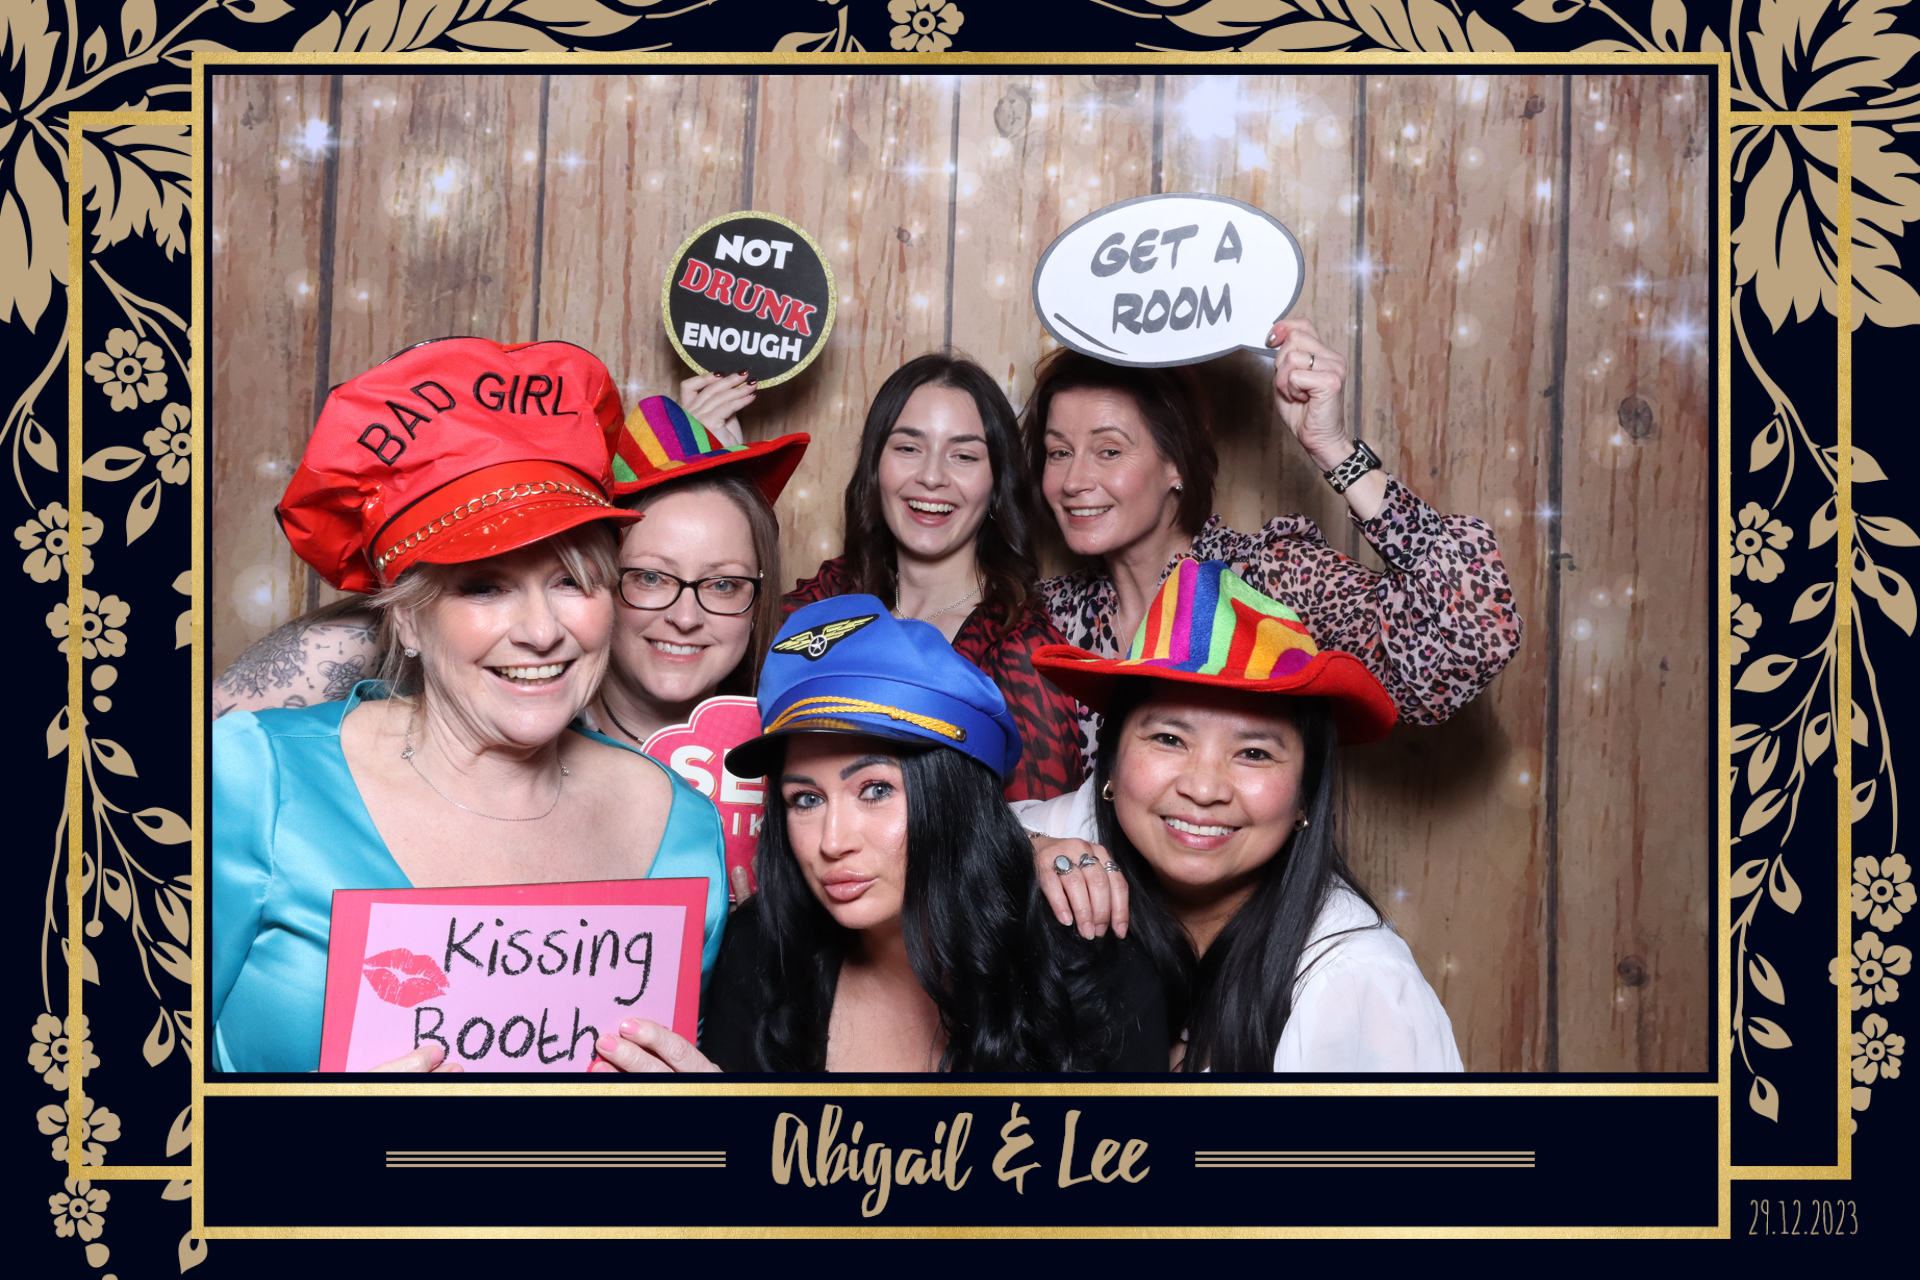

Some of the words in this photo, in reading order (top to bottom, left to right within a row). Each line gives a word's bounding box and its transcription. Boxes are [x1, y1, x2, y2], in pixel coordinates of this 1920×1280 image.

[714, 233, 794, 270] NOT
[1090, 224, 1200, 278] GET
[1213, 220, 1243, 264] A
[678, 257, 818, 336] DRUNK
[1111, 282, 1233, 335] ROOM
[681, 321, 803, 362] ENOUGH
[357, 380, 457, 467] BAD
[472, 371, 579, 417] GIRL
[443, 917, 653, 1006] Kissing
[413, 1006, 600, 1066] Booth
